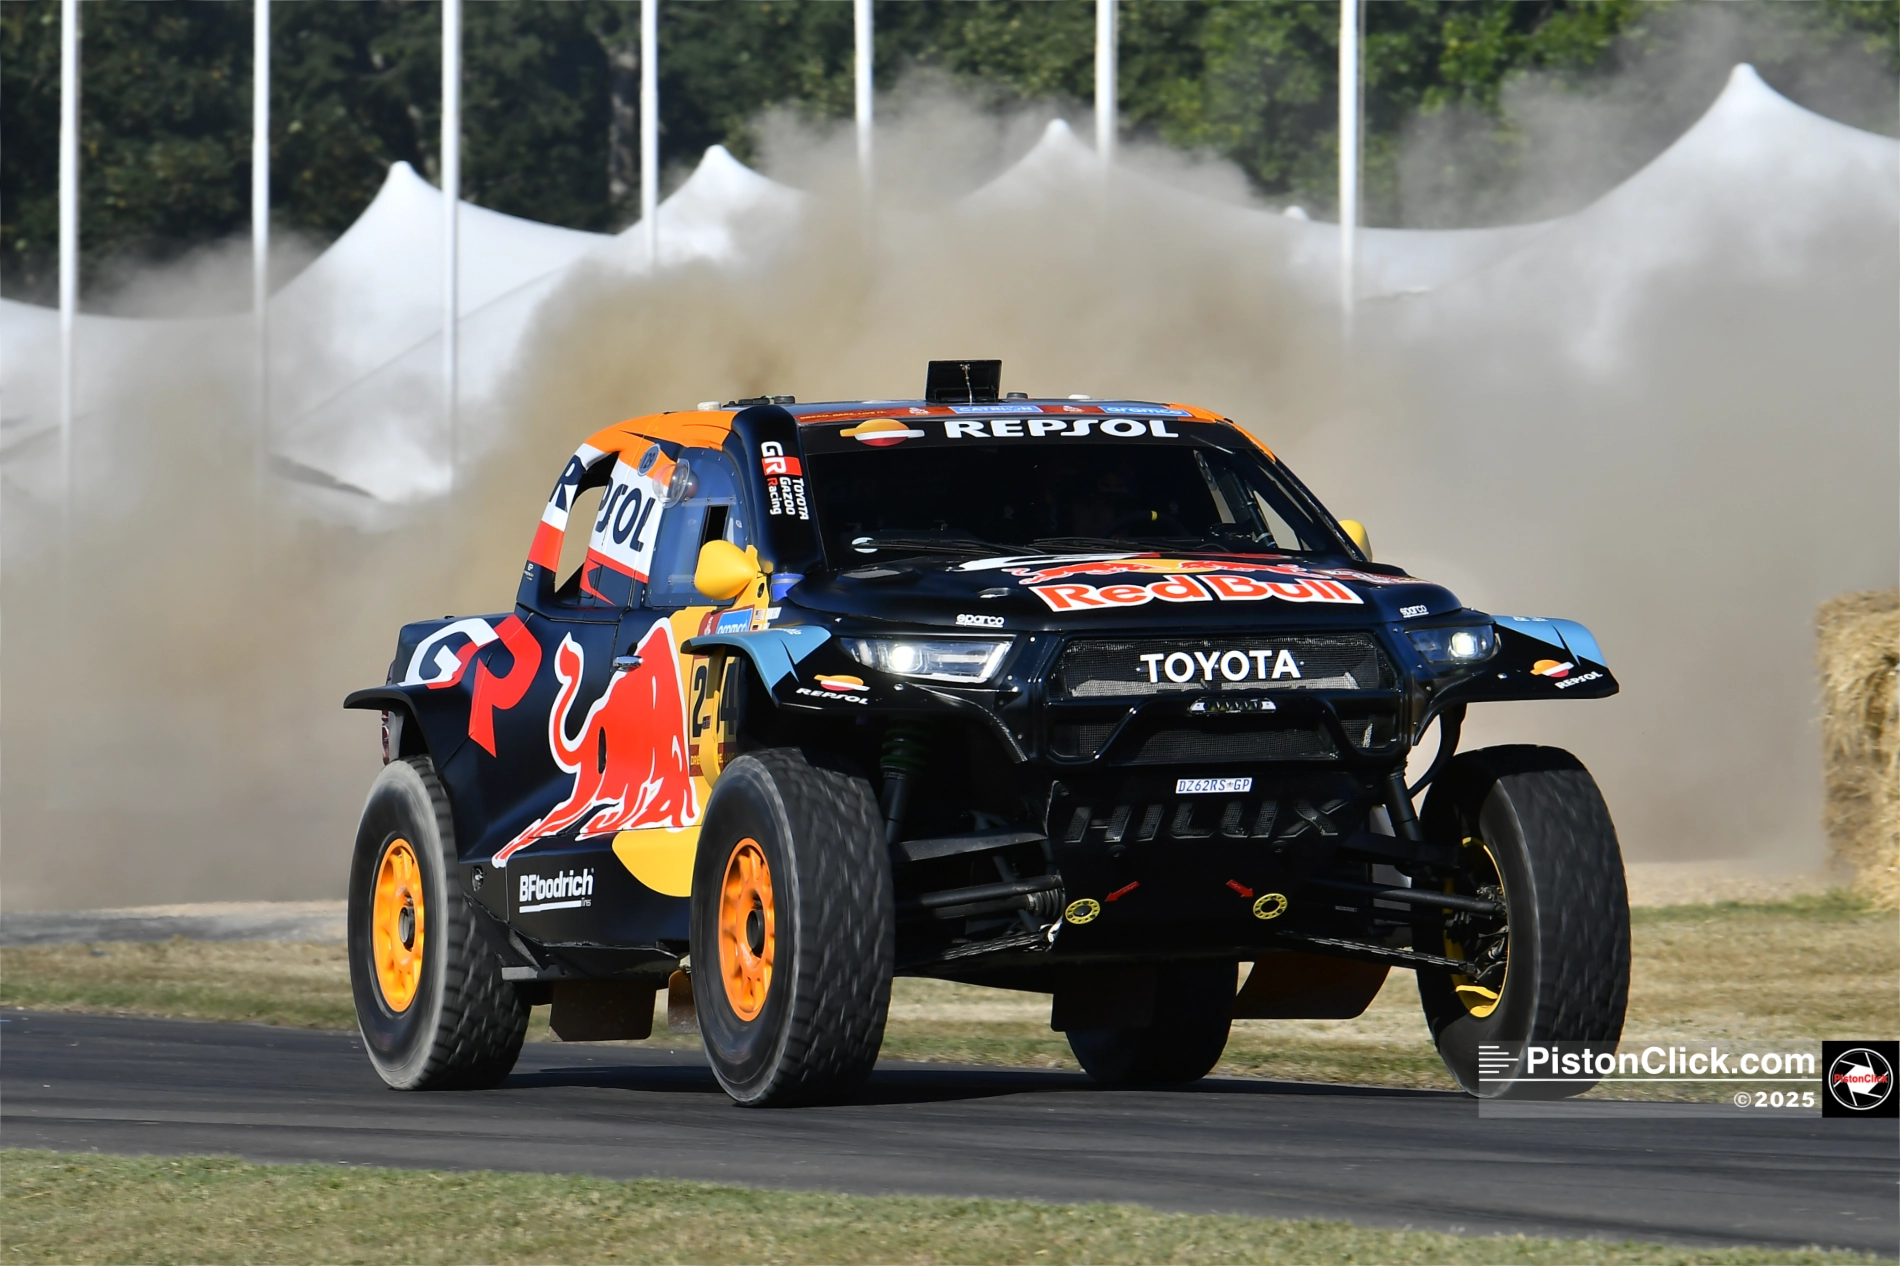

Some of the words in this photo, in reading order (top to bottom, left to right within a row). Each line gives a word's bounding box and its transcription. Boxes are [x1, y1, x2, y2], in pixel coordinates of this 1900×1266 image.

[944, 418, 1180, 438] REPSOL
[761, 441, 787, 475] GR
[767, 477, 783, 515] Racing
[779, 477, 796, 515] GAZOO
[792, 478, 810, 520] TOYOTA
[1034, 575, 1207, 610] Red
[1206, 575, 1353, 601] Bull
[956, 613, 1005, 626] sparco
[1400, 604, 1428, 617] sparco
[1140, 649, 1301, 683] TOYOTA
[1554, 671, 1603, 690] REPSOL
[796, 687, 869, 705] REPSOL
[1064, 799, 1349, 843] HILUX
[519, 867, 594, 902] BFGoodrich
